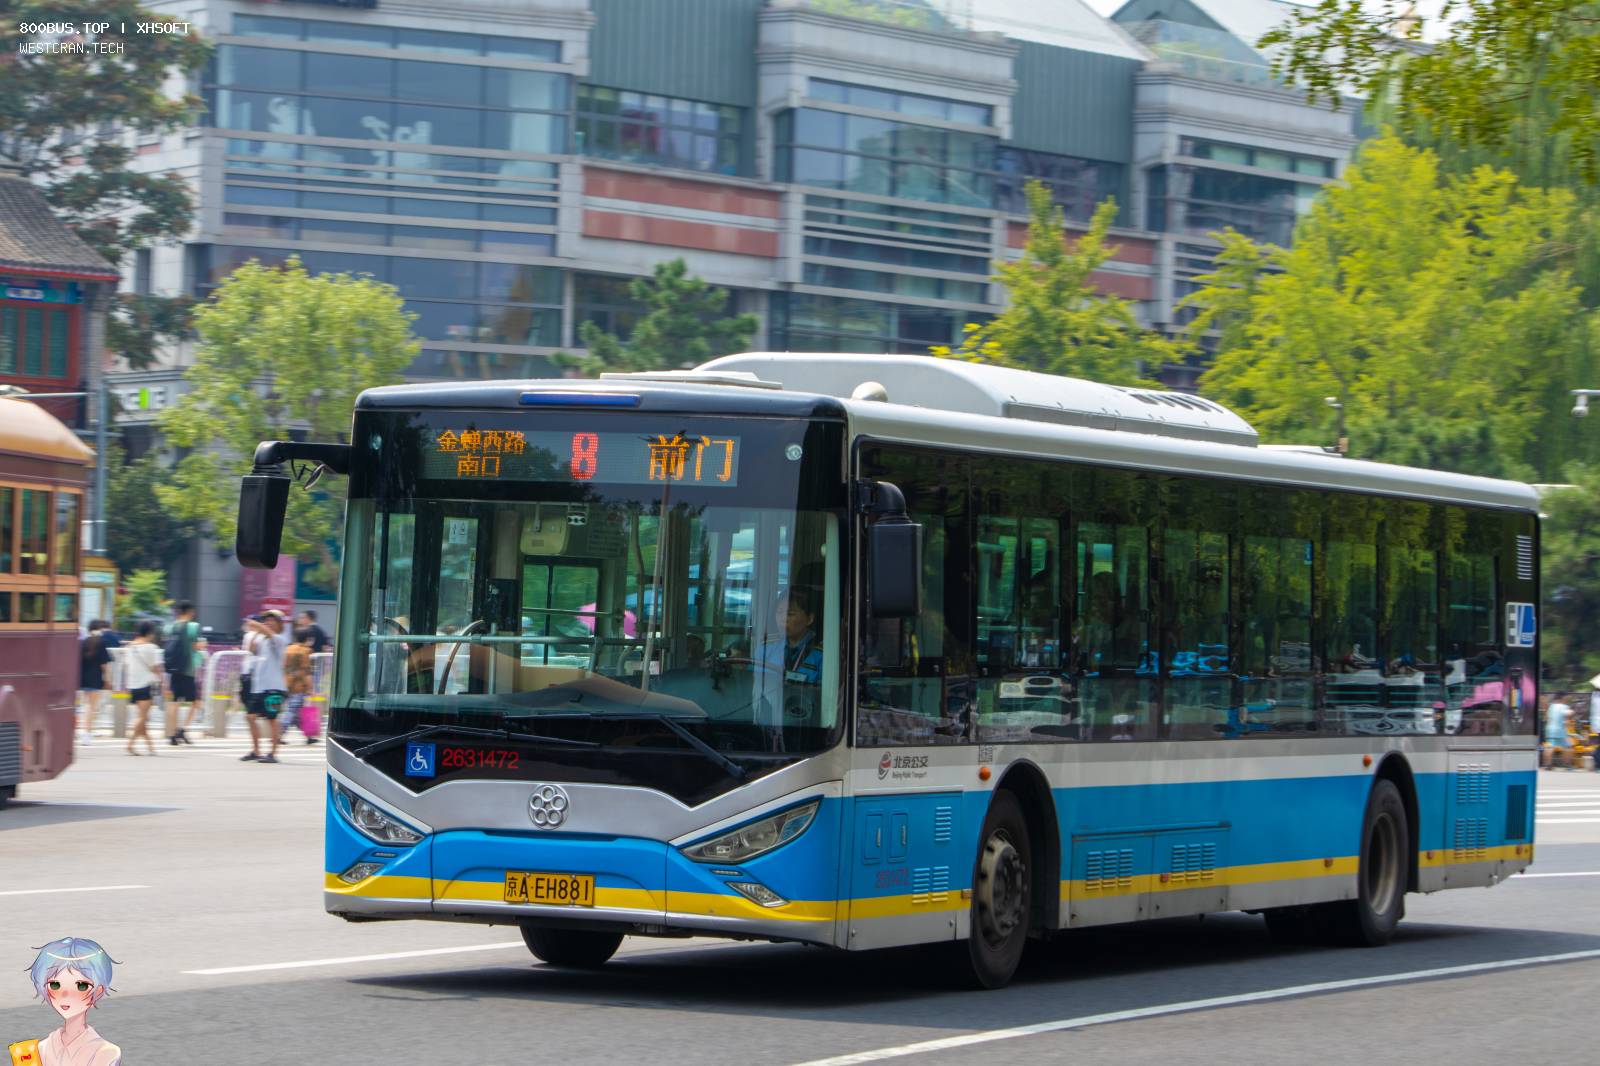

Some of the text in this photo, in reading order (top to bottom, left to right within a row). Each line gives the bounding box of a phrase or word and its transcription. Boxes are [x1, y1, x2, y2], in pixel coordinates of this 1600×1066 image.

[457, 452, 501, 479] 南口
[571, 433, 599, 480] 8
[647, 434, 735, 482] 前门
[441, 747, 520, 769] 2631472
[892, 755, 929, 769] 北京公交
